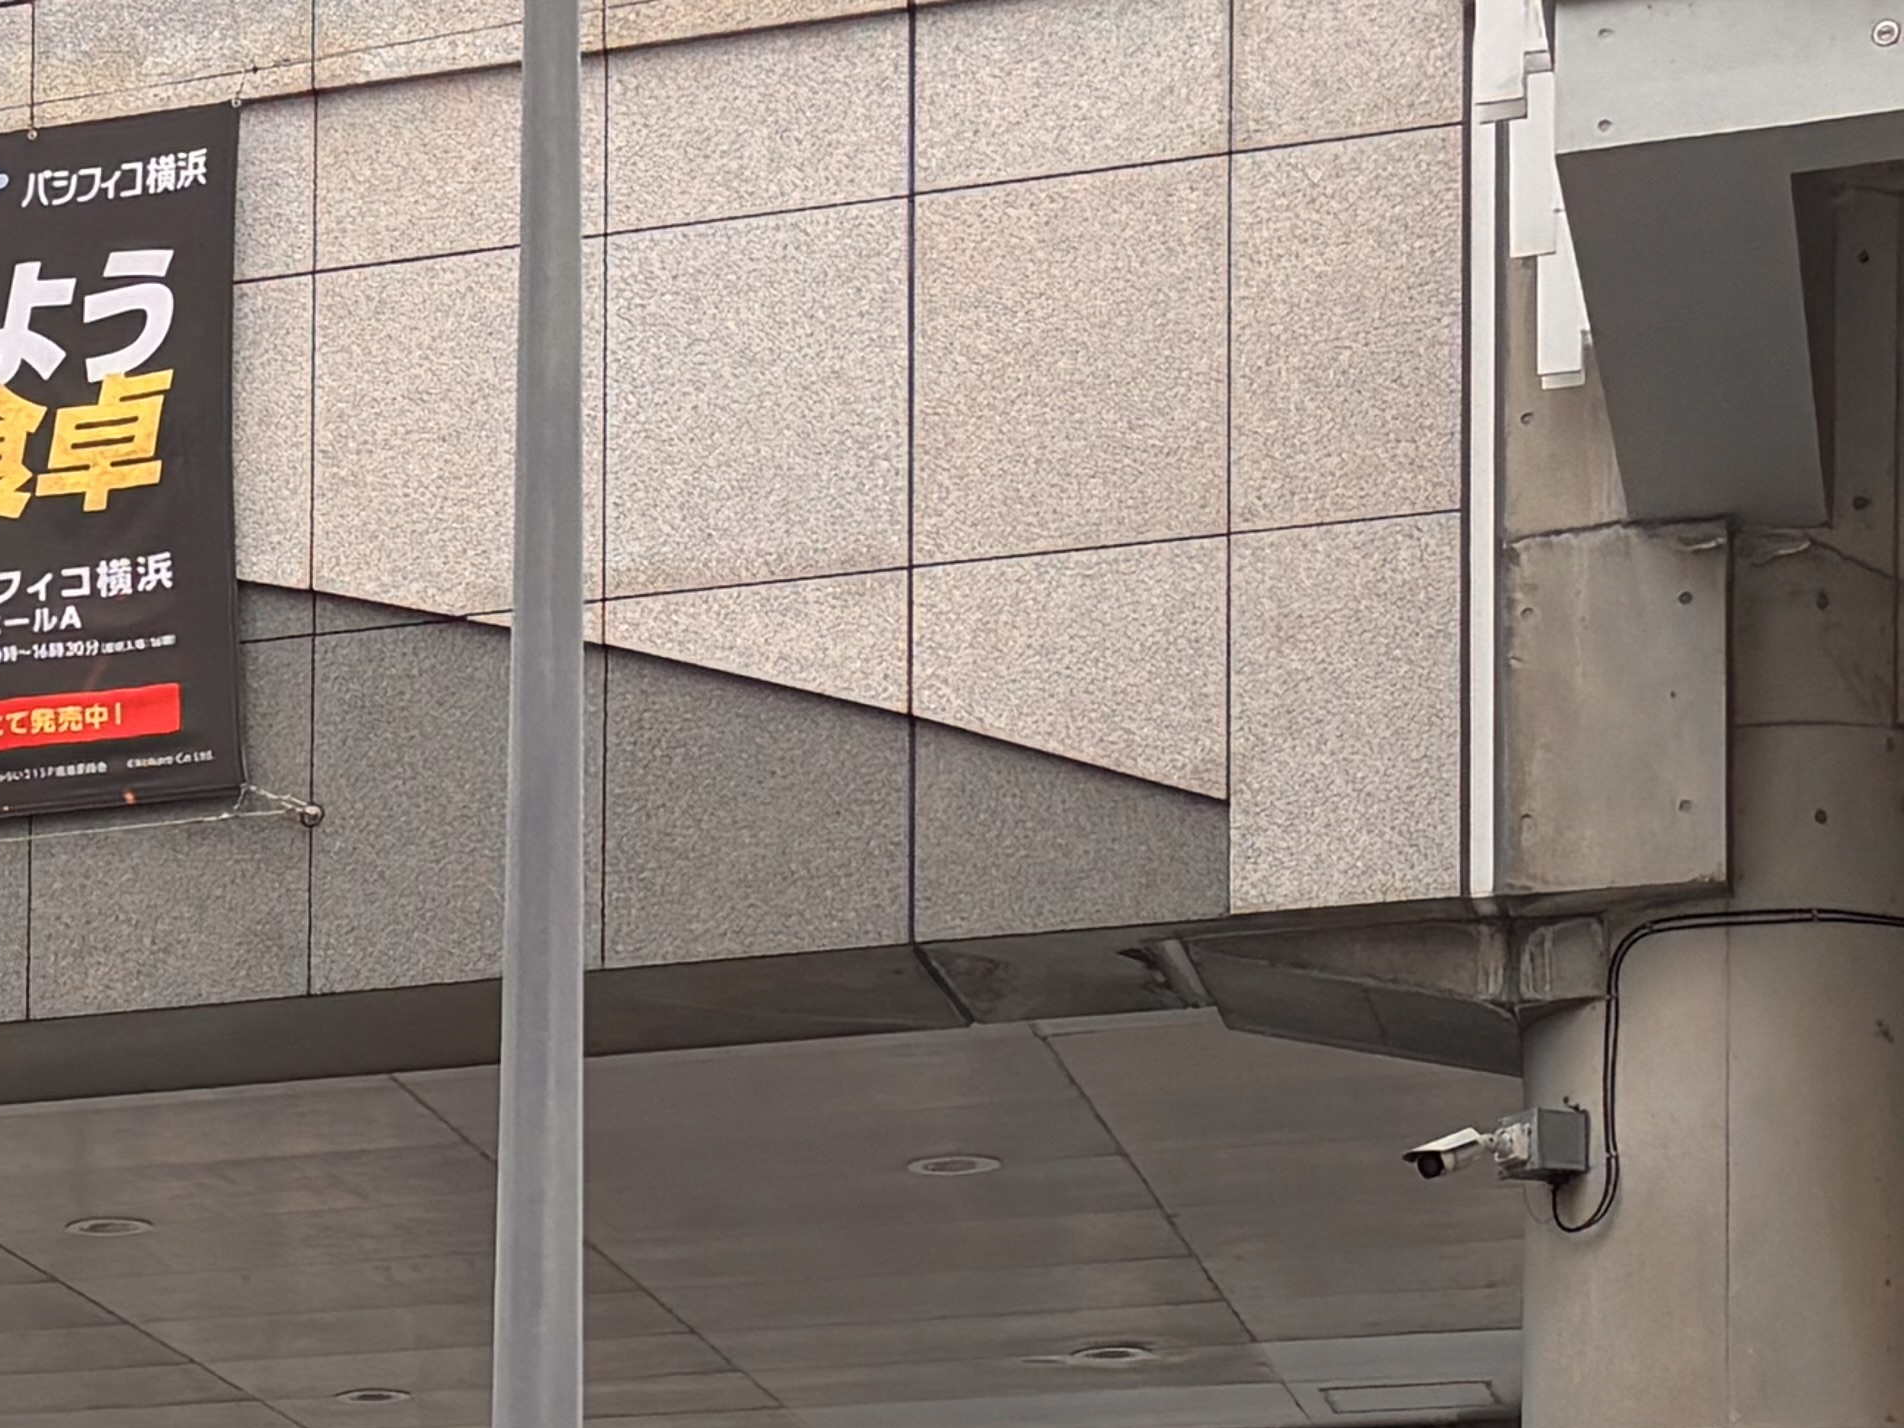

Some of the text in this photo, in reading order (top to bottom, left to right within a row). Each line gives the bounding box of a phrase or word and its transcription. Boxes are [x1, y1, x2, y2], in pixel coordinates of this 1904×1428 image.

[21, 149, 207, 208] パシフィコ横浜
